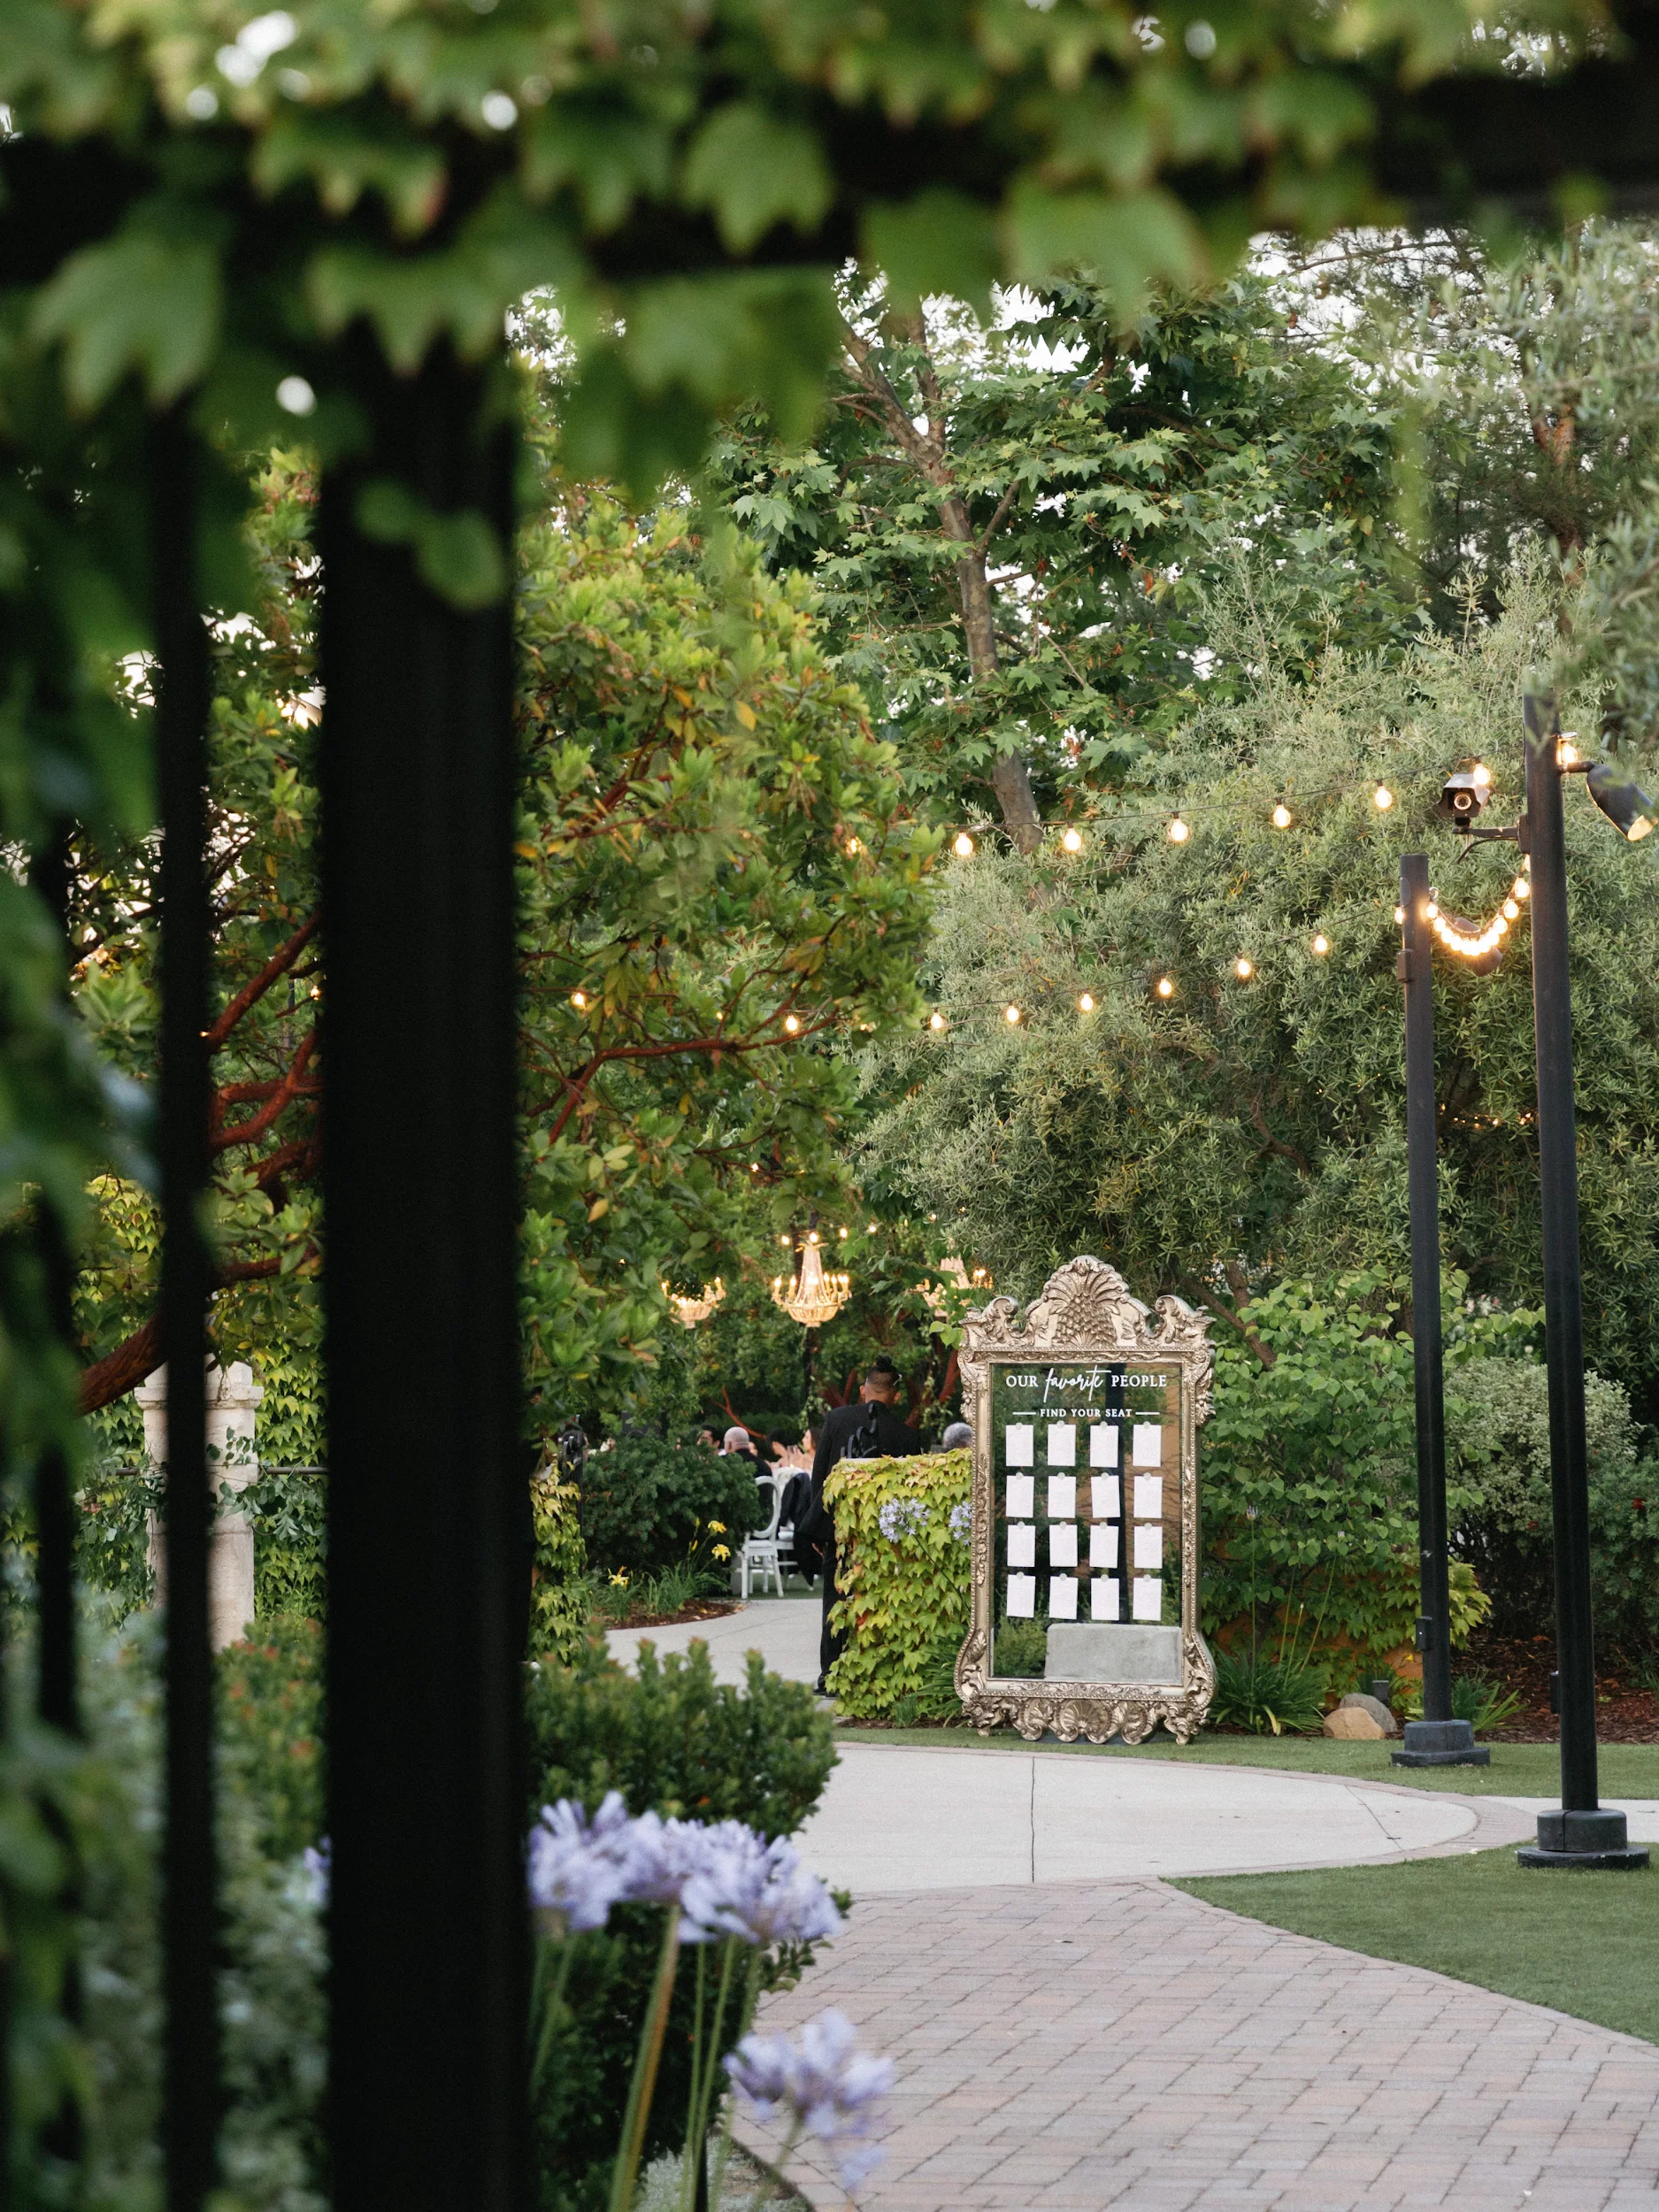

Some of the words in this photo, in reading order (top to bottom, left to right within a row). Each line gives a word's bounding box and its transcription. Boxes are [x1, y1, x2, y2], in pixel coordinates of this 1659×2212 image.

[1006, 1375, 1039, 1387] OUR
[1043, 1364, 1111, 1402] favorite
[1111, 1375, 1167, 1387] PEOPLE
[1040, 1409, 1066, 1417] FIND
[1070, 1409, 1102, 1417] YOUR
[1105, 1409, 1133, 1417] SEAT
